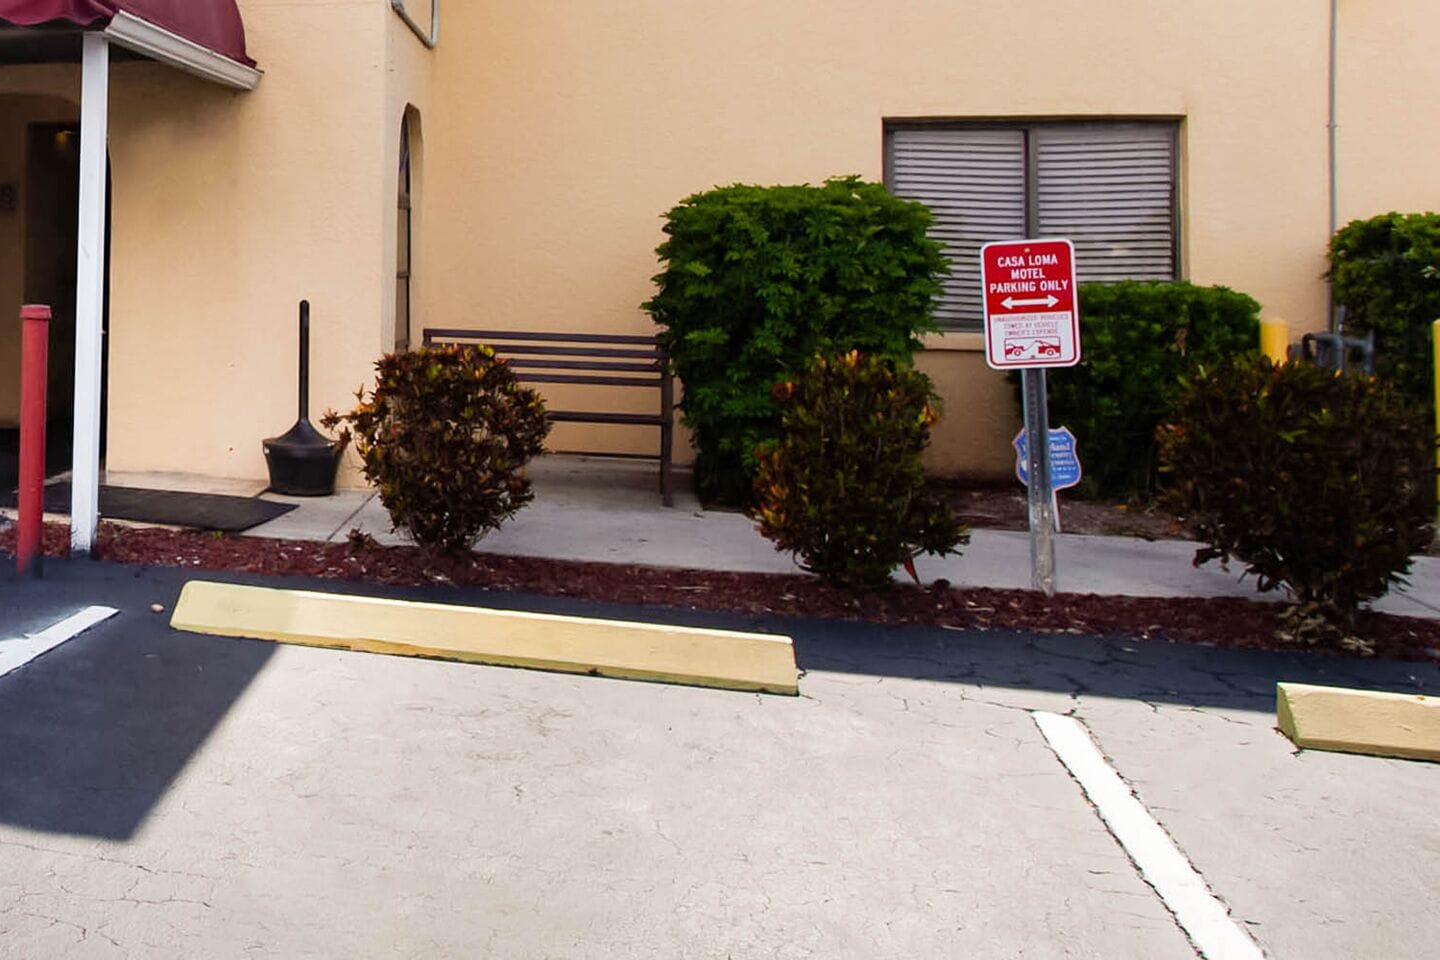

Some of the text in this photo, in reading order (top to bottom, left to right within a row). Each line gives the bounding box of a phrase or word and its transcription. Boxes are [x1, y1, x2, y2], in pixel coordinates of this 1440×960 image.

[997, 254, 1058, 267] CASA LOMA
[1011, 268, 1046, 279] MOTEL
[990, 280, 1068, 294] PARKING ONLY
